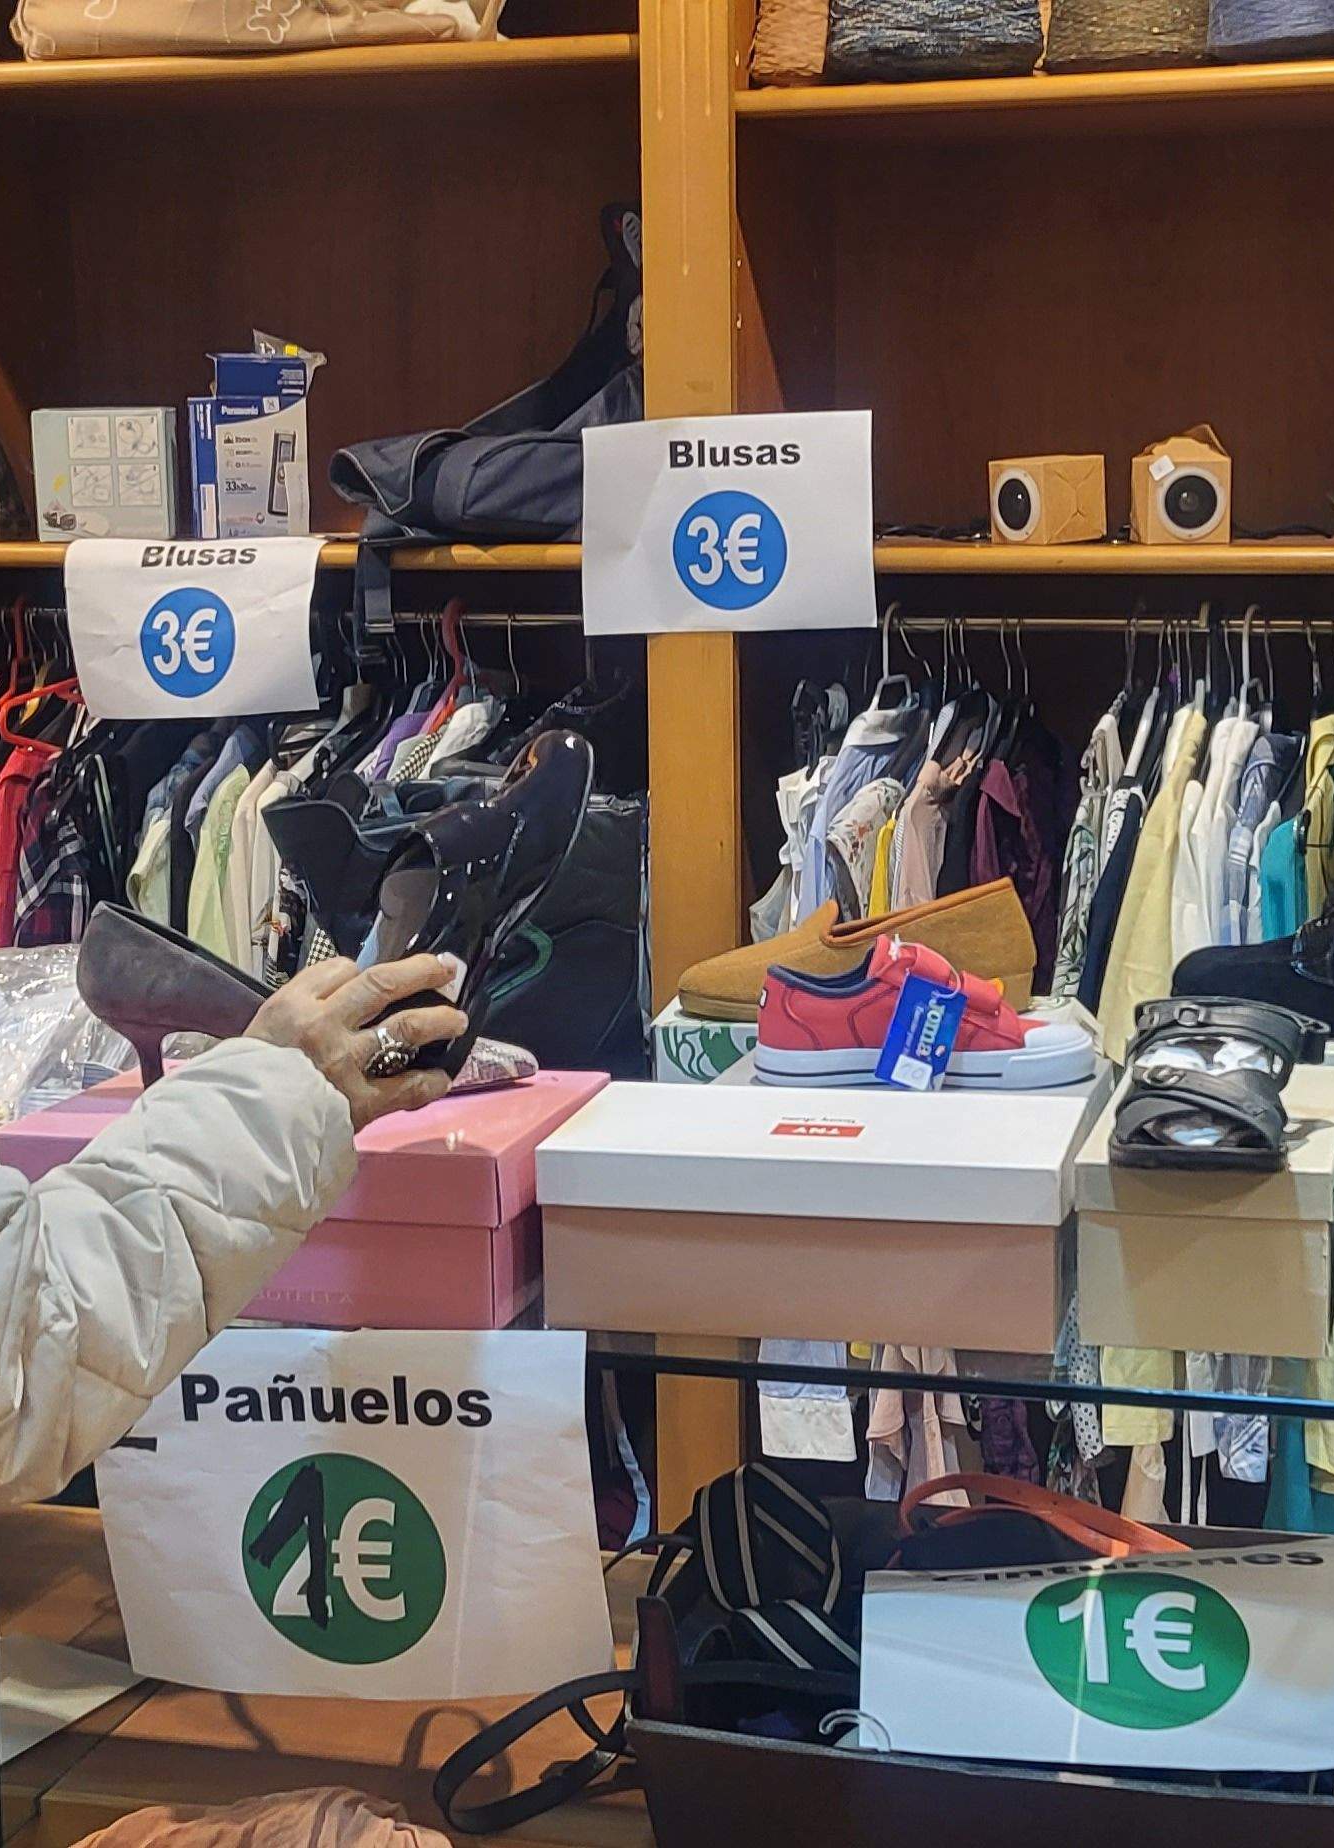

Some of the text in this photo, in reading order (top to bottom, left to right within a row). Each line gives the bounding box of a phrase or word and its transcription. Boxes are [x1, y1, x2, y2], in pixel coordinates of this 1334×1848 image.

[669, 440, 801, 469] Blusas
[141, 546, 258, 568] Blusas
[687, 513, 765, 586] 3€
[152, 608, 218, 676] 3€
[916, 998, 946, 1057] Joma
[181, 1374, 493, 1428] Pañuelos
[1057, 1589, 1207, 1691] 1€
